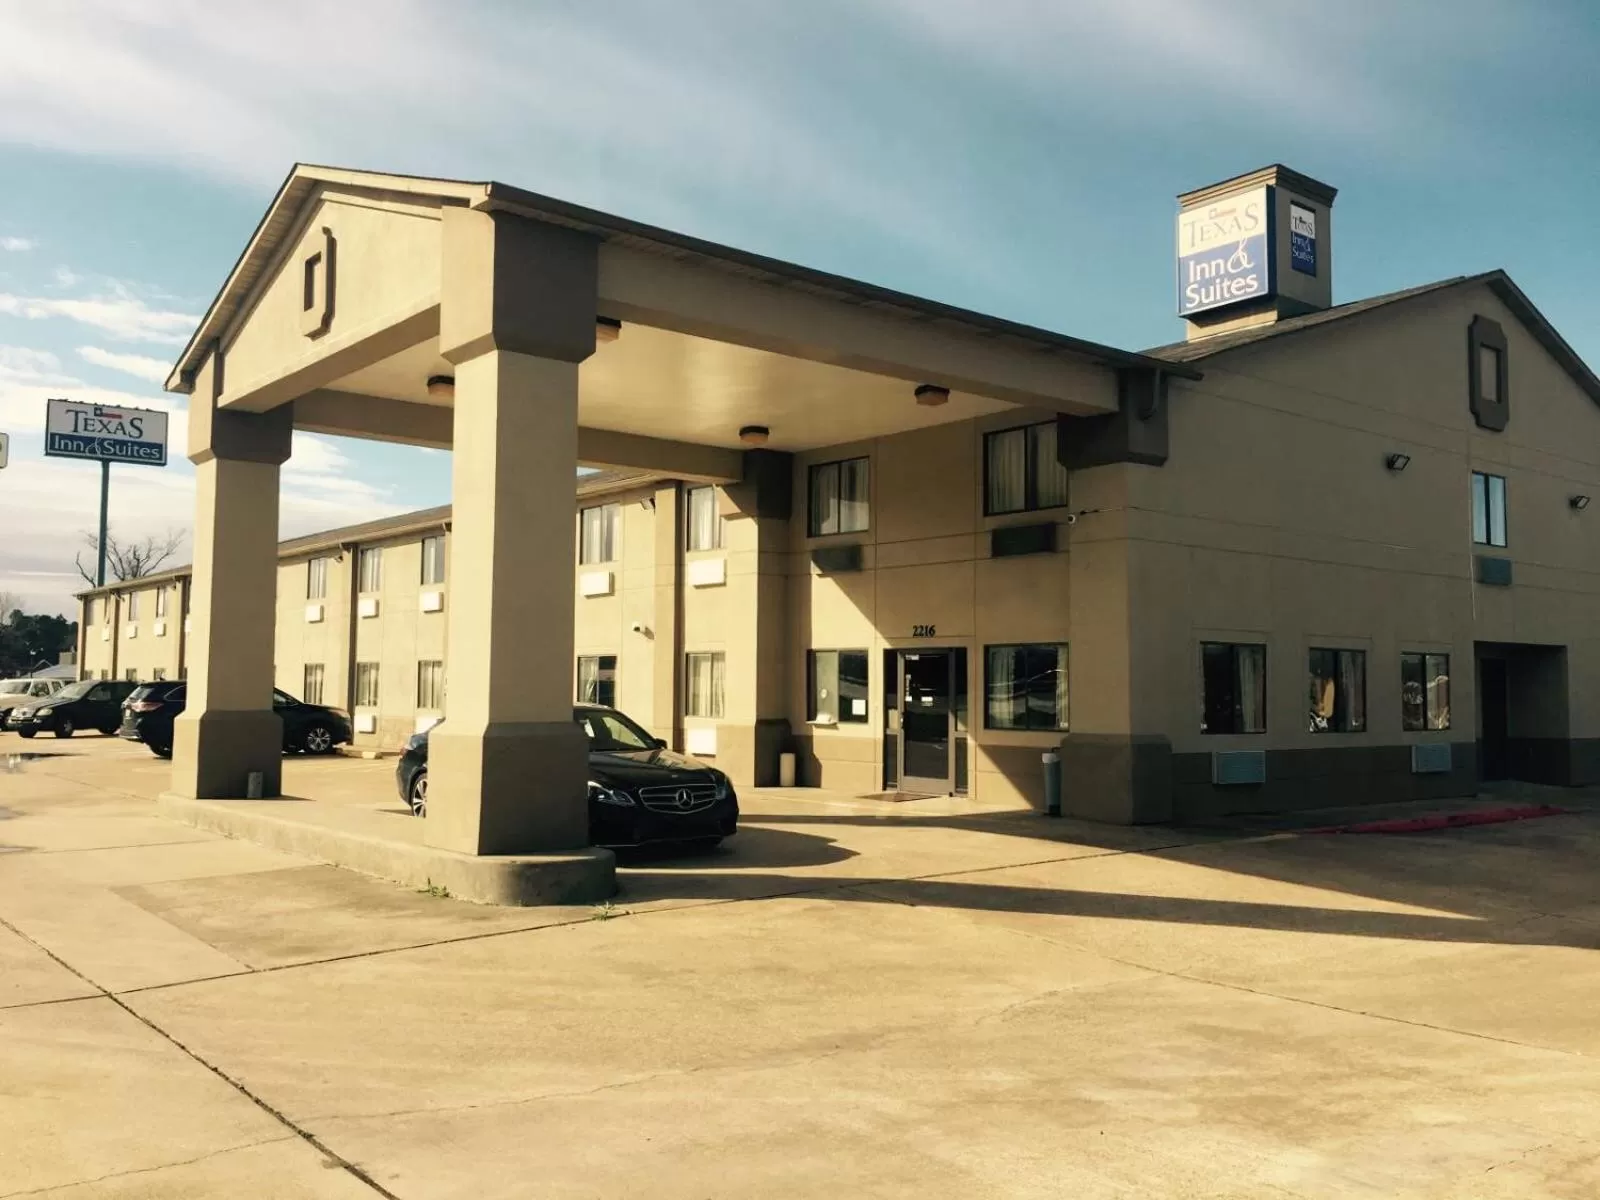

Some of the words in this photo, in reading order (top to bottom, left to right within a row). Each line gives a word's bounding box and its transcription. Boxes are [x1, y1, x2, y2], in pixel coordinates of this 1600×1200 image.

[1183, 202, 1260, 248] TEXAS
[1189, 258, 1225, 283] Inn
[1227, 236, 1256, 273] &
[1185, 273, 1258, 308] Suites
[65, 409, 144, 439] TEXAS
[54, 435, 84, 451] Inn
[102, 440, 160, 459] Suites
[912, 625, 936, 637] 2216
